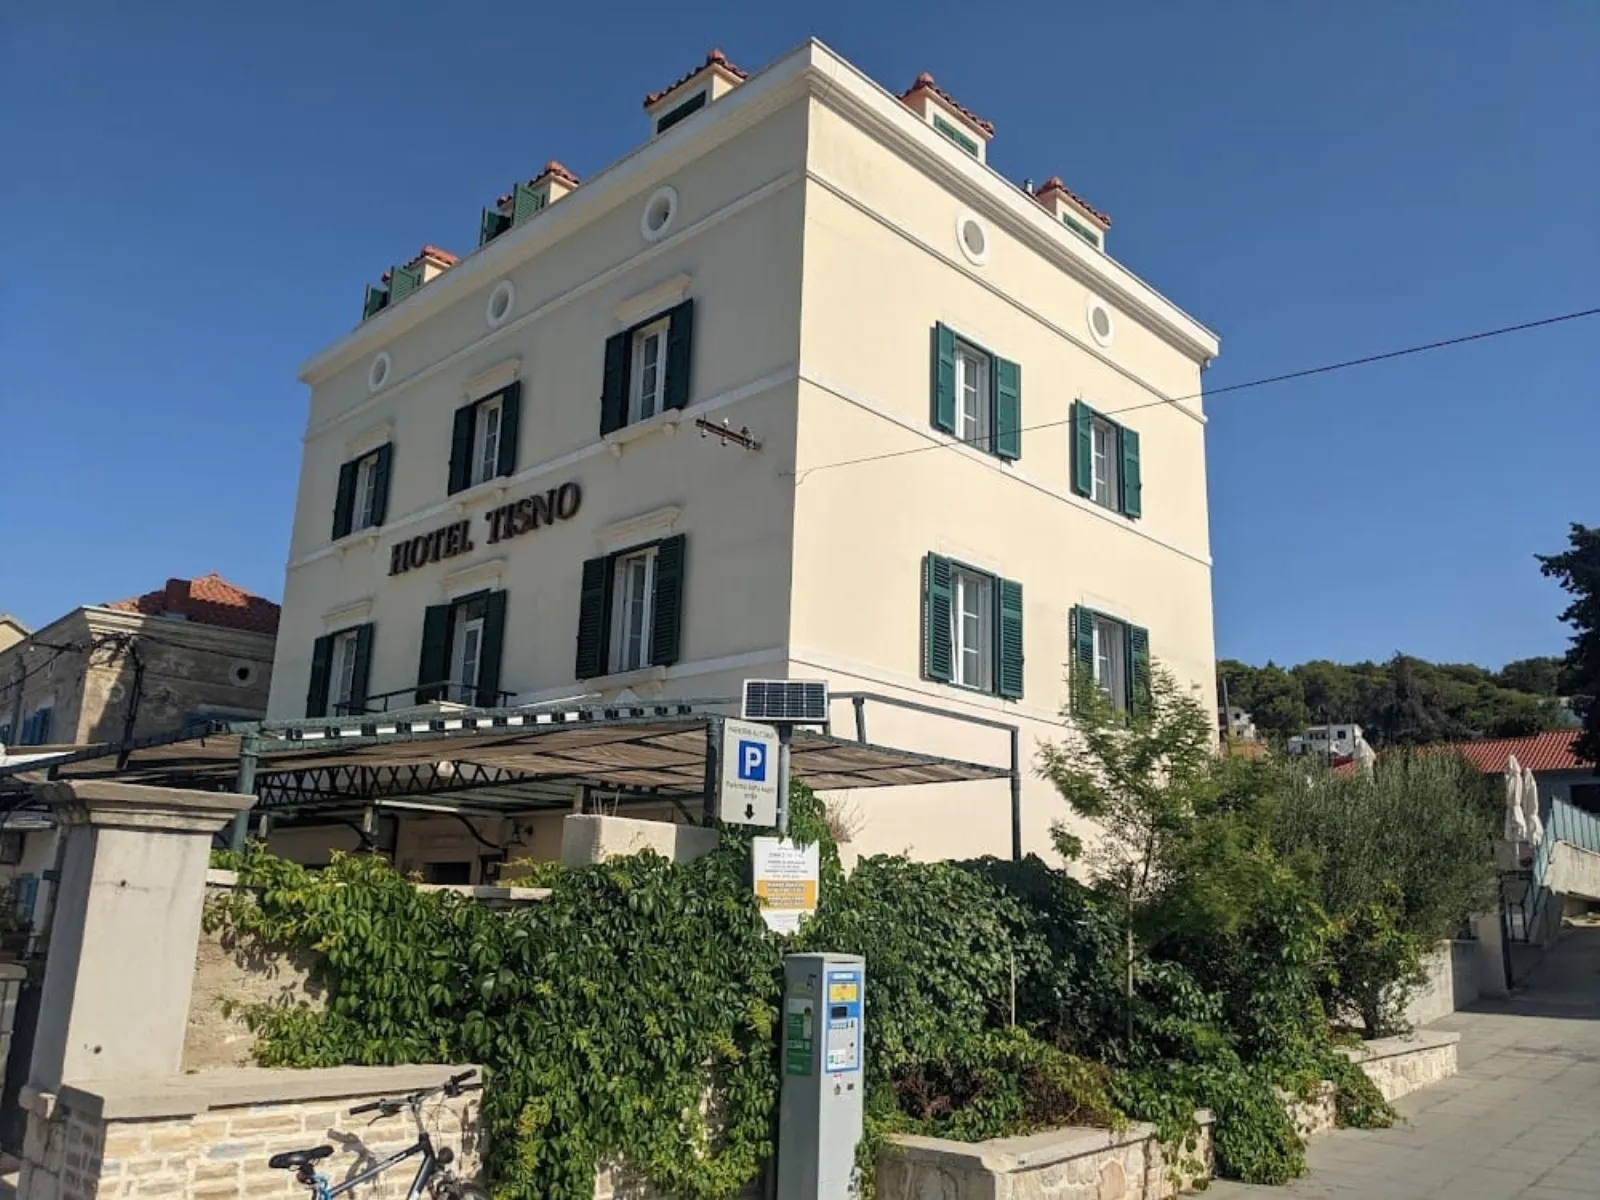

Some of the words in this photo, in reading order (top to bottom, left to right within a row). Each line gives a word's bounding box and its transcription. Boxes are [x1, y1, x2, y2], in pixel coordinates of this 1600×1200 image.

[388, 520, 474, 576] HOTEL
[485, 482, 582, 544] TISNO
[745, 746, 763, 776] P
